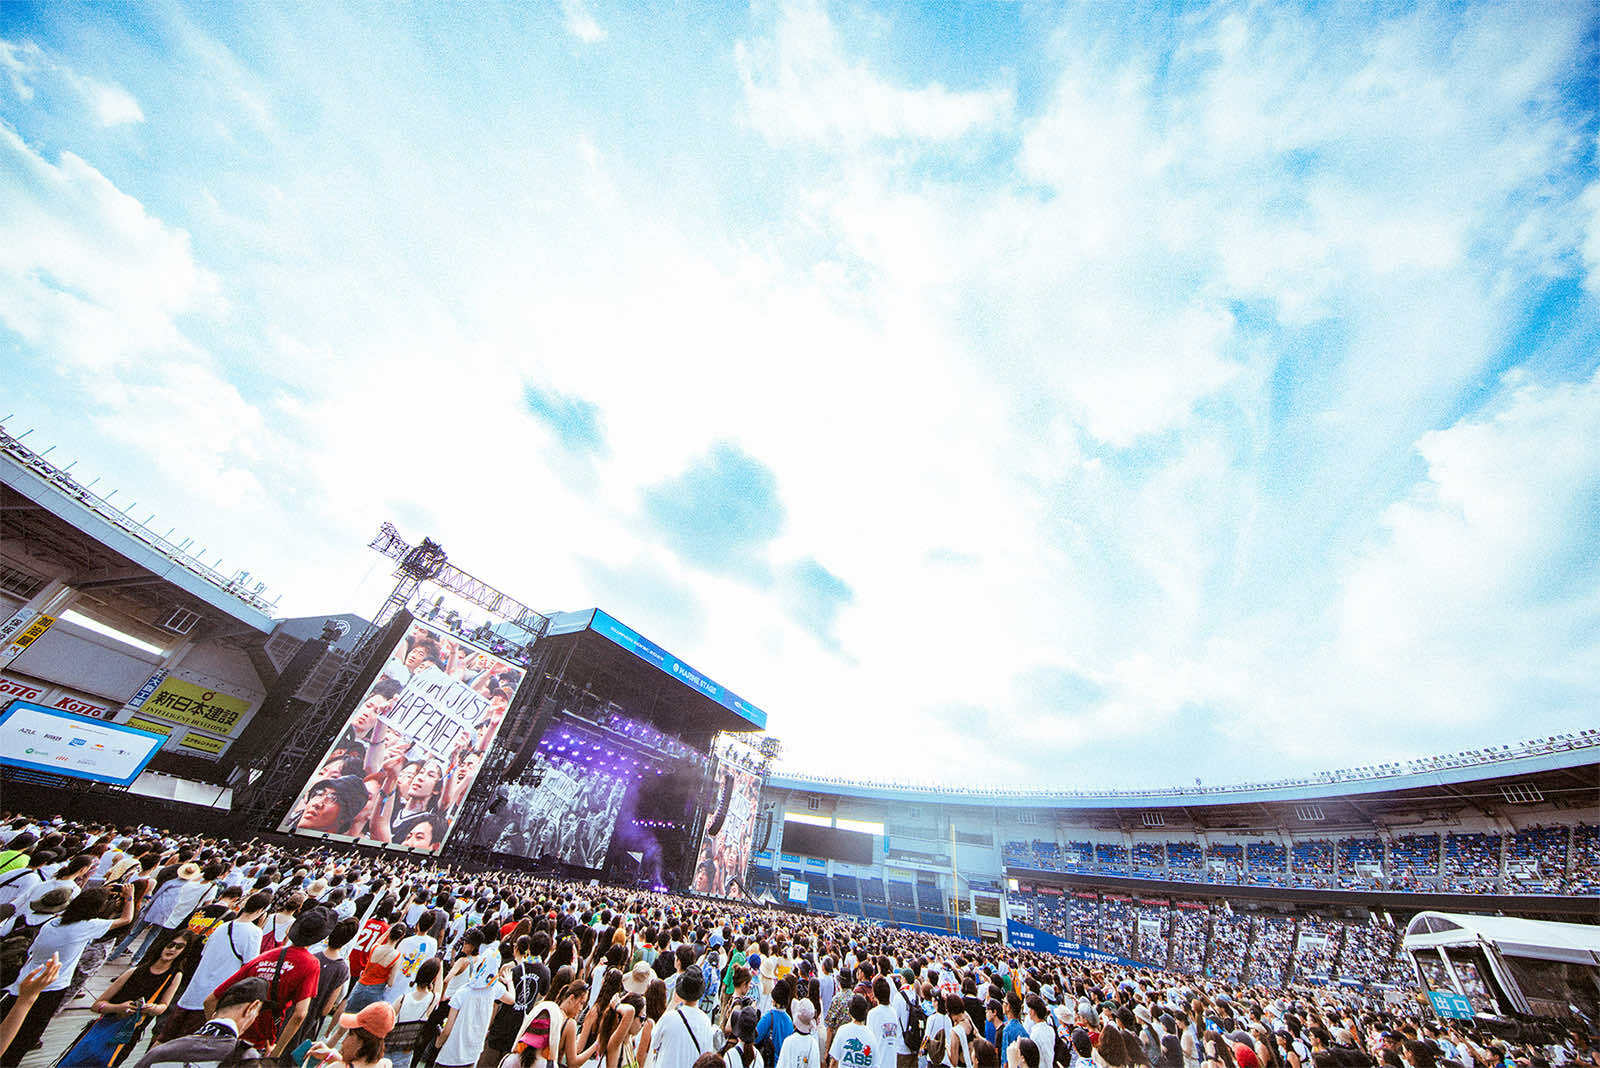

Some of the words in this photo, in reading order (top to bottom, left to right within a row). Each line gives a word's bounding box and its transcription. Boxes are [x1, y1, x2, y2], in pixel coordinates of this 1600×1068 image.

[151, 689, 239, 726] 新日本建設
[353, 928, 381, 953] 21
[1433, 996, 1470, 1012] 出口
